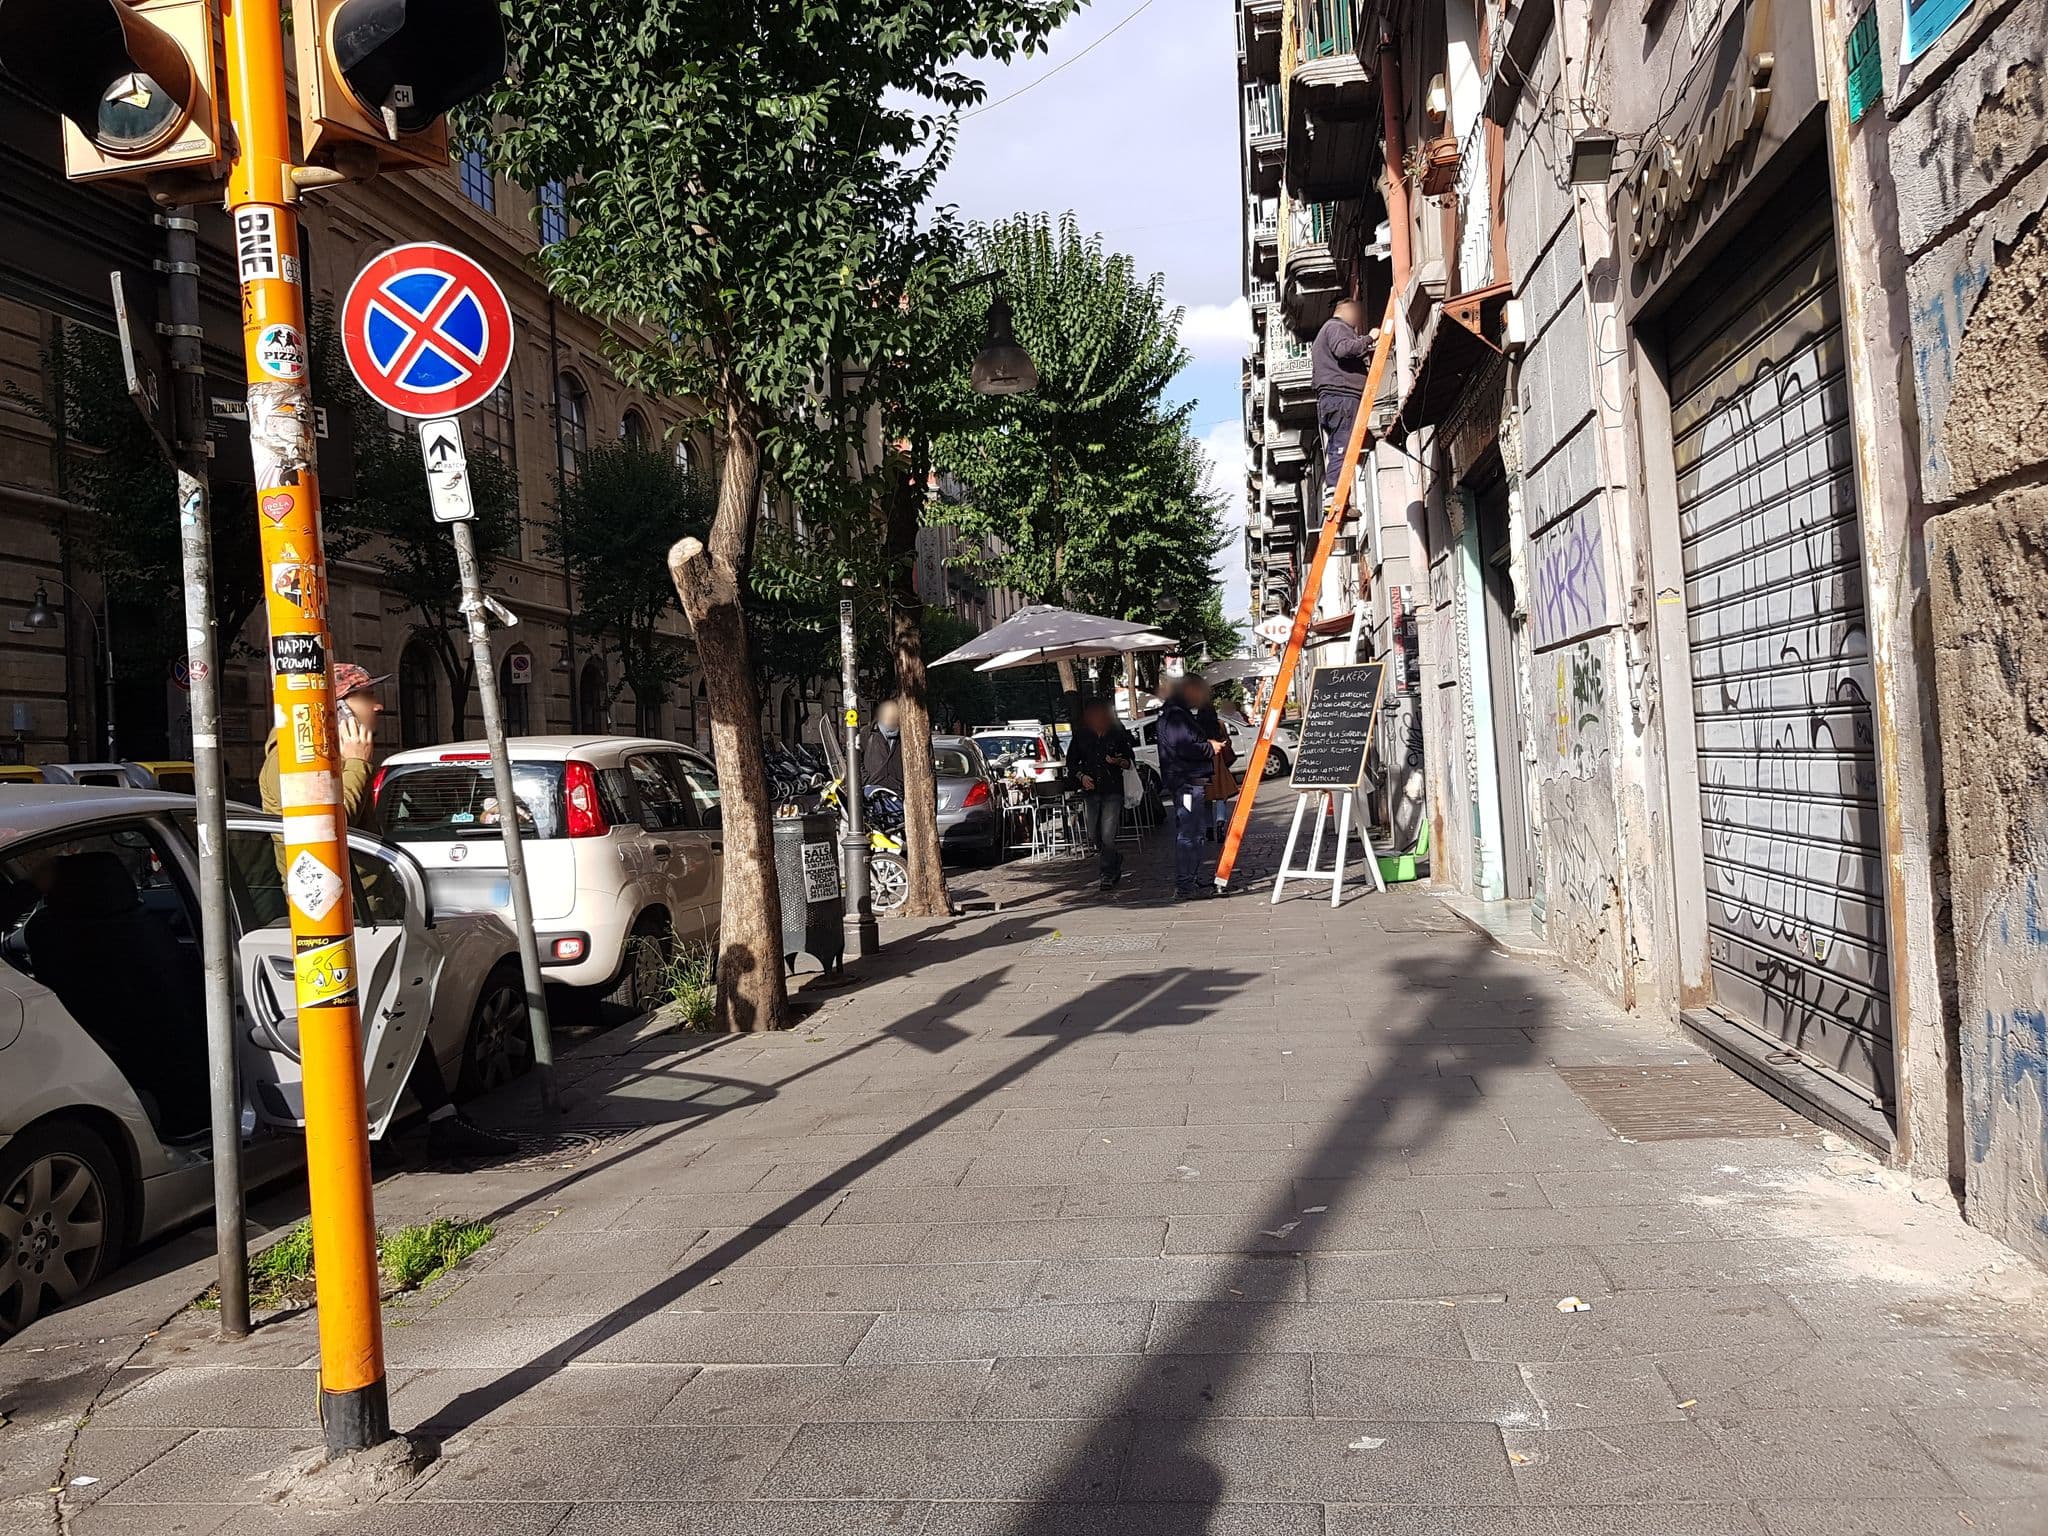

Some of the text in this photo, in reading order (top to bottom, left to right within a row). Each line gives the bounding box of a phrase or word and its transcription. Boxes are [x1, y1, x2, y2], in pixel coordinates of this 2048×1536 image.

[238, 213, 274, 277] BNE
[264, 351, 304, 365] PIZZO
[277, 640, 313, 654] HAPPY
[276, 656, 318, 671] CROWN!
[1328, 669, 1372, 686] BAKERY
